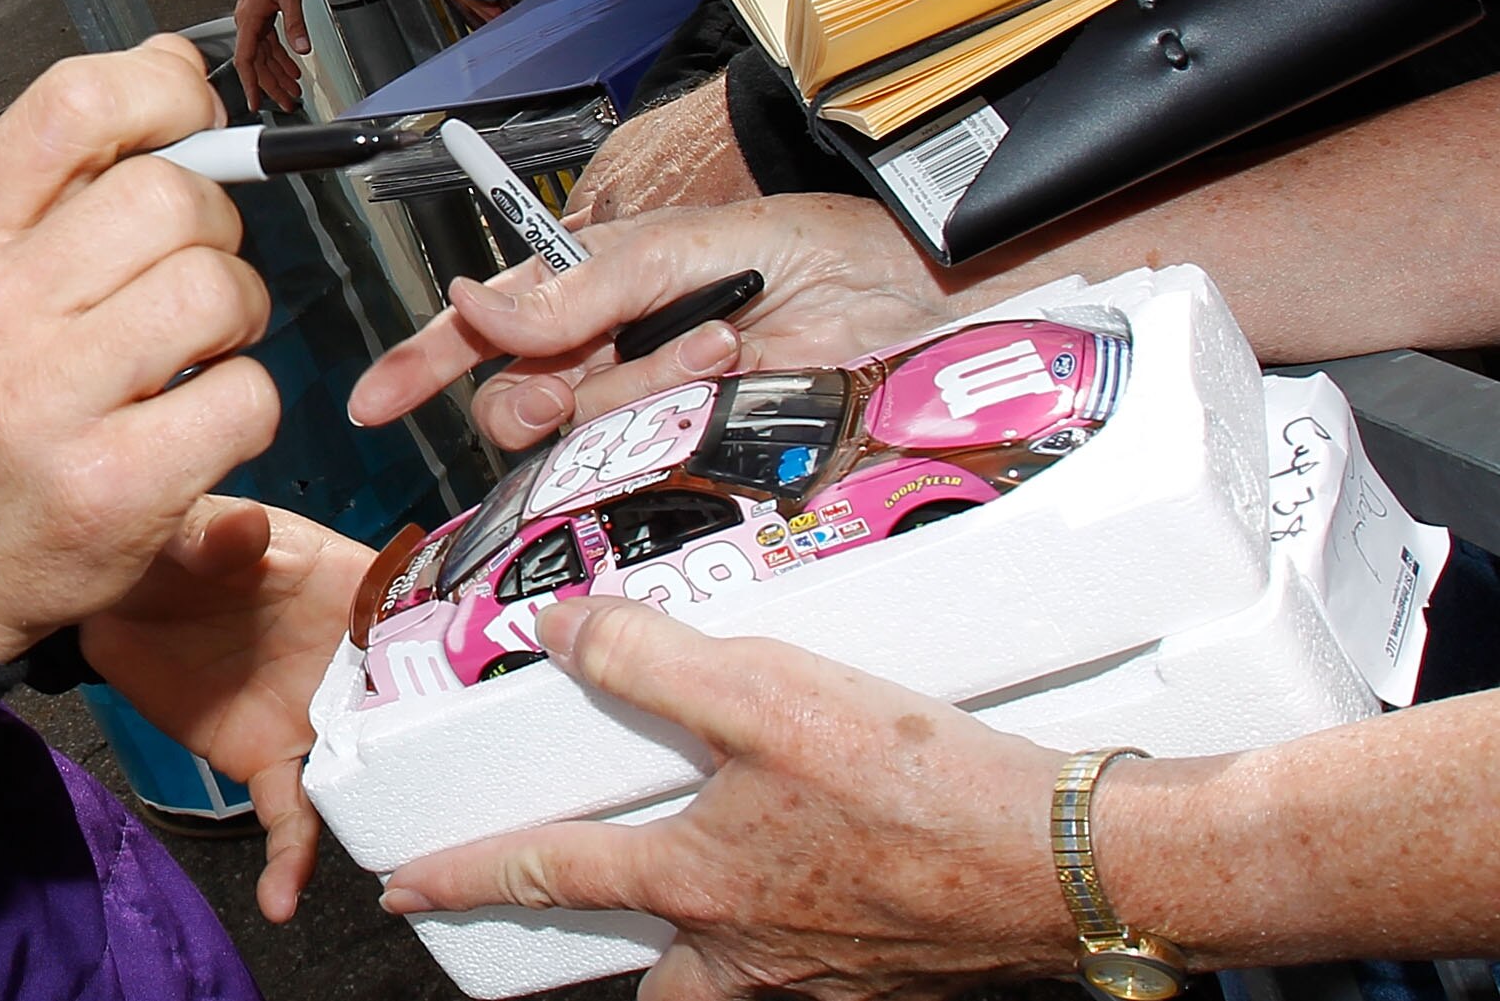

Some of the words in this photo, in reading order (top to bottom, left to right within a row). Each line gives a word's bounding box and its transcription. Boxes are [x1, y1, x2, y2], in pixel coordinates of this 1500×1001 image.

[492, 189, 522, 223] METALLIC
[1269, 416, 1332, 479] Cup
[884, 473, 963, 509] GOODYEAR
[1270, 487, 1315, 542] 38
[381, 574, 406, 611] cure
[1384, 635, 1398, 659] LLC
